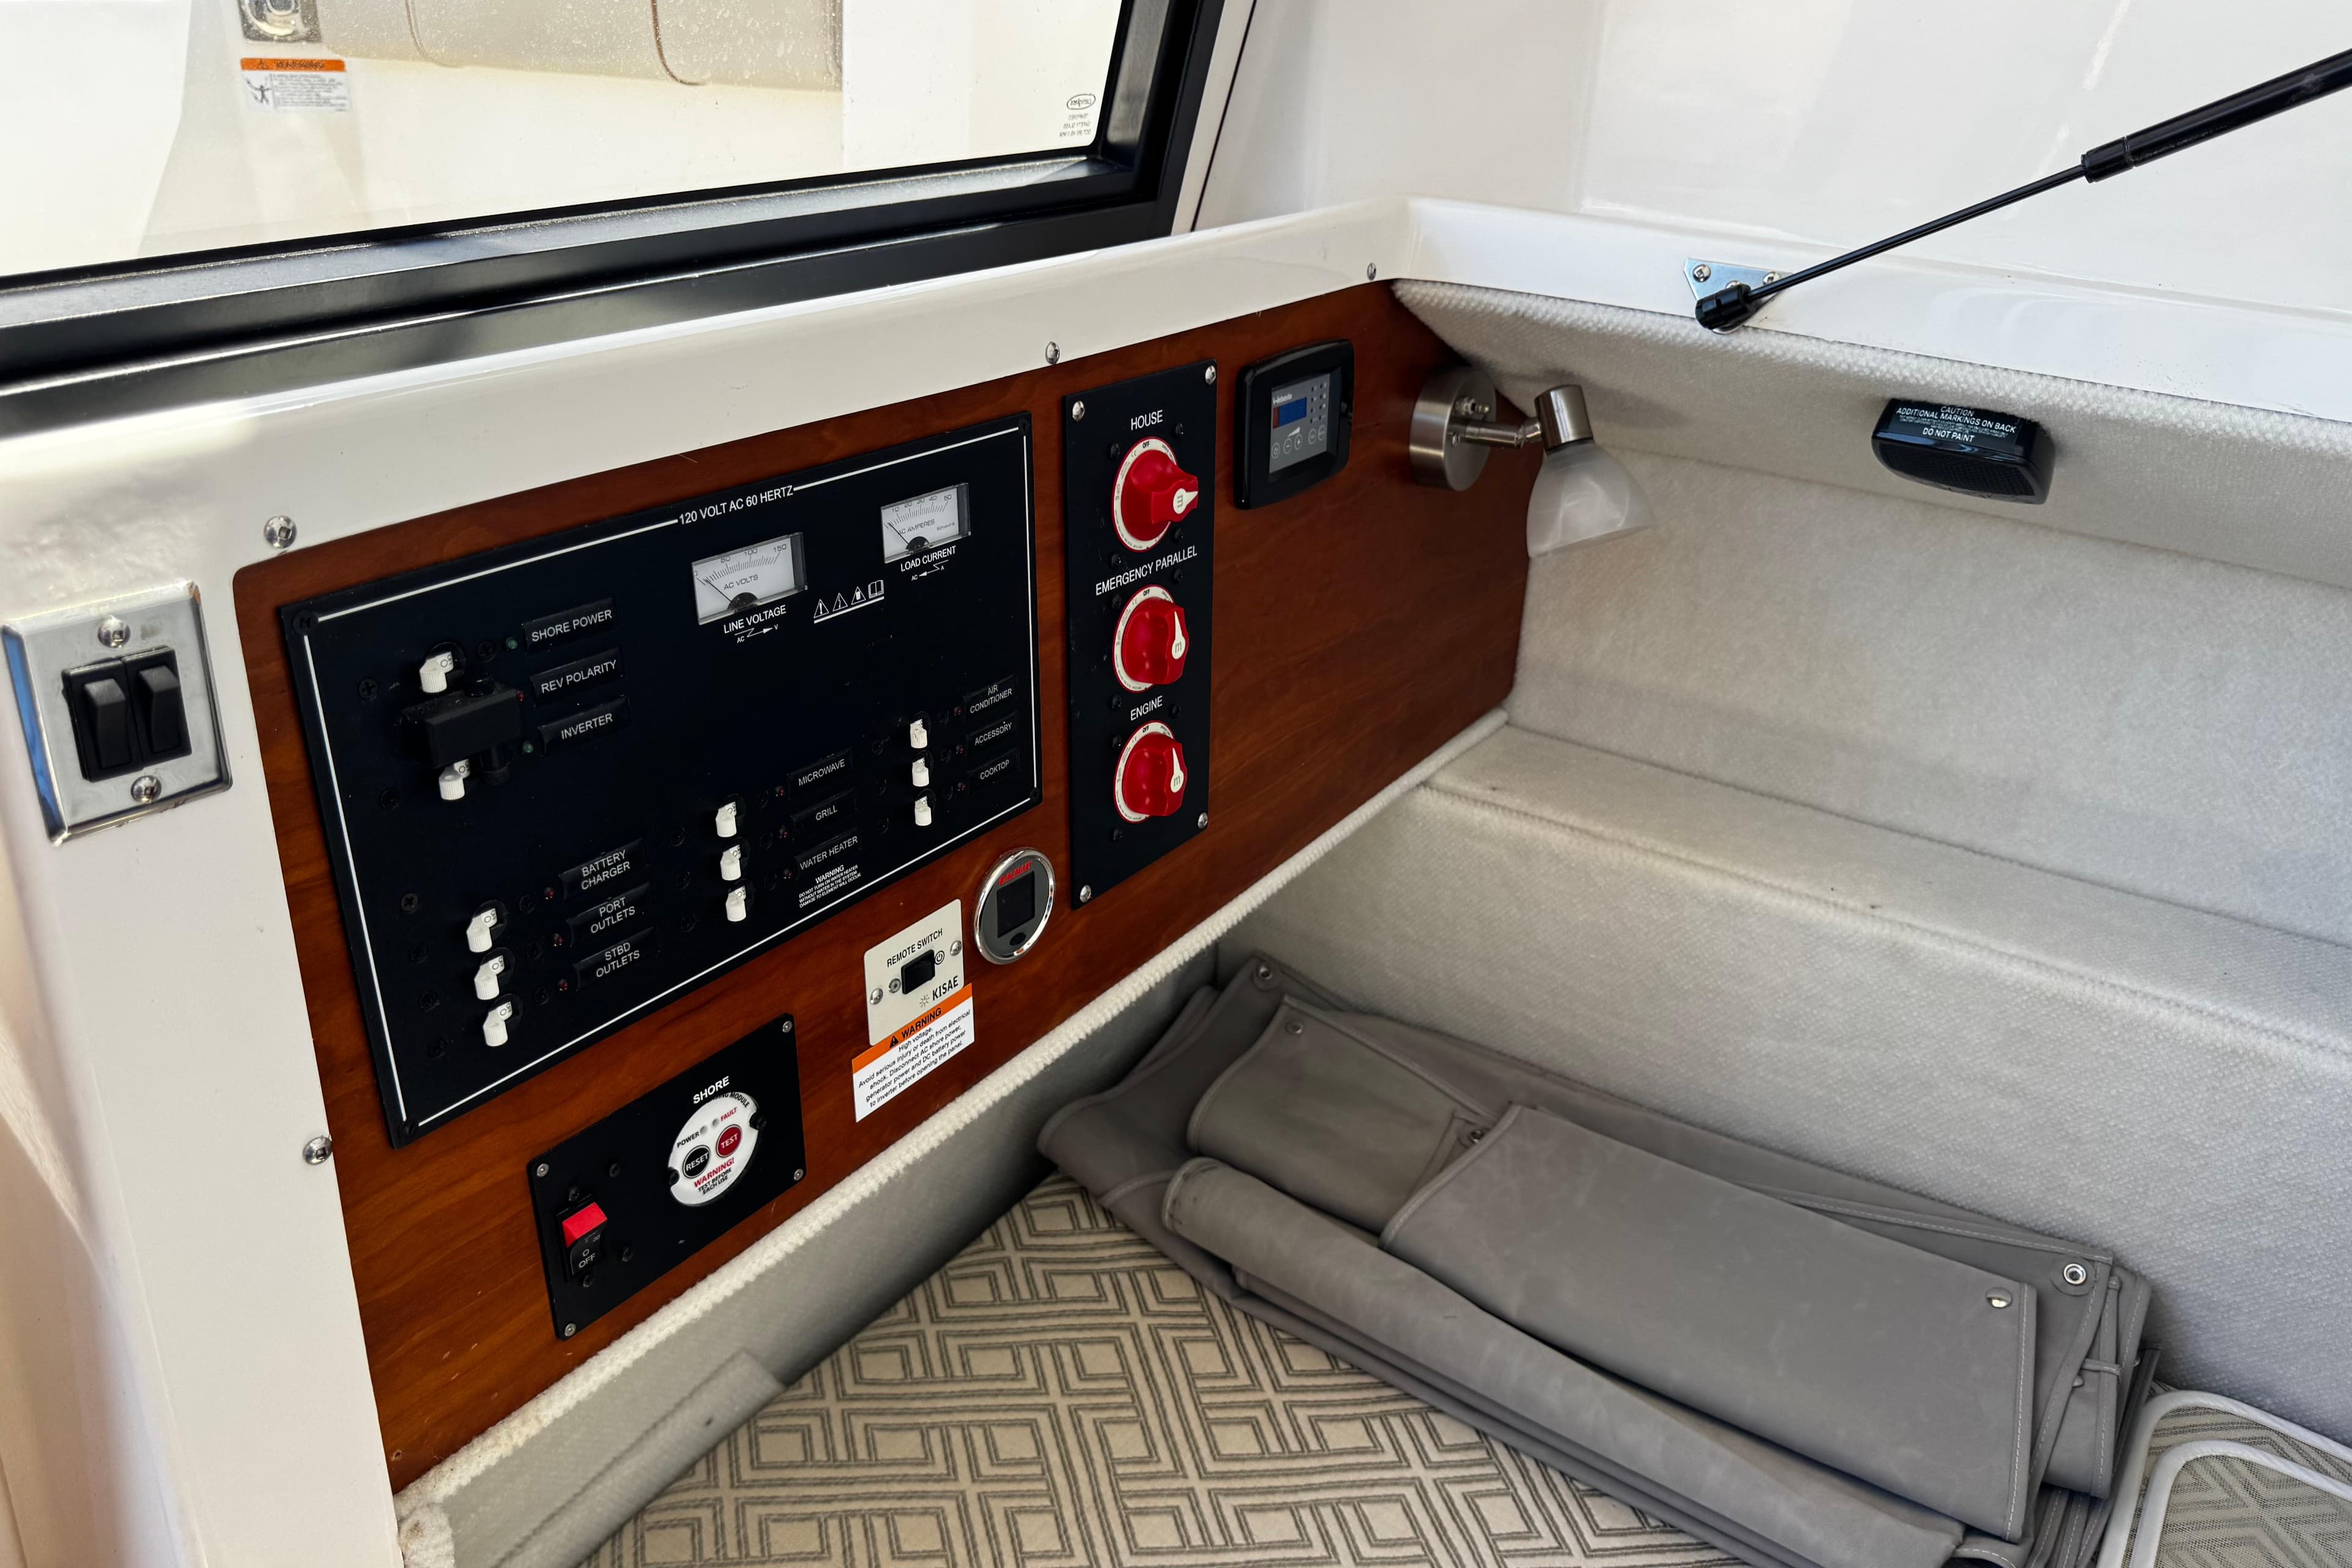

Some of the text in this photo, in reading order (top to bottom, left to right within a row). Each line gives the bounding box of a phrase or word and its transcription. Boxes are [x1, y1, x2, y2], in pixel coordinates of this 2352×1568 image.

[1131, 410, 1163, 431] HOUSE
[1896, 407, 1939, 419] ADDITIONAL
[1940, 413, 1981, 426] MARKINGS
[1994, 423, 2016, 433] BACK
[1940, 406, 1975, 417] CAUTION
[1934, 429, 1951, 439] NOT
[1951, 432, 1975, 443] PAINT
[679, 485, 793, 524] 120 VOLT AC 60 HERTZ
[908, 519, 935, 532] AMPERES
[774, 544, 786, 552] 150
[900, 545, 956, 571] LOAD CURRENT
[736, 574, 758, 586] VOLTS
[1095, 545, 1198, 596] EMERGENCY PARALLEL
[532, 609, 612, 642] SHORE POWER
[723, 605, 786, 634] LINE VOLTAGE
[541, 660, 616, 693] REV POLARITY
[970, 688, 1012, 714] CONDITIONER
[988, 684, 998, 696] AIR
[1131, 695, 1163, 721] ENGINE
[561, 713, 613, 740] INVERTER
[974, 722, 1012, 745] ACCESSORY
[799, 759, 845, 786] MICROWAVE
[980, 759, 1009, 780] COOKTOP
[815, 805, 838, 821] GRILL
[582, 850, 626, 877] BATTERY
[799, 836, 858, 870] WATER HEATER
[581, 861, 630, 889] CHARGER
[815, 864, 844, 884] WARNING
[831, 873, 843, 882] WATER
[799, 891, 816, 903] WITHOUT
[817, 884, 830, 894] WATER
[822, 884, 839, 896] ELEMENT
[591, 906, 635, 933] OUTLETS
[600, 897, 626, 917] PORT
[605, 942, 631, 961] STBD
[887, 928, 943, 968] REMOTE SWITCH
[597, 950, 640, 977] OUTLETS
[932, 975, 959, 1001] KISAE
[901, 1008, 941, 1039] WARNING
[859, 1075, 875, 1088] Avoid
[875, 1061, 896, 1077] serious
[897, 1050, 912, 1063] injury
[919, 1035, 935, 1048] death
[935, 1026, 948, 1038] from
[948, 1009, 970, 1028] electrical
[899, 1027, 933, 1052] High voltage.
[865, 1030, 966, 1102] generator power and DC battery power
[870, 1076, 889, 1090] shock.
[889, 1054, 919, 1077] Disconnect
[920, 1046, 929, 1055] AC
[930, 1037, 944, 1049] shore
[876, 1087, 897, 1103] inverter
[899, 1074, 916, 1090] before
[916, 1059, 938, 1077] opening
[938, 1053, 948, 1062] the
[948, 1041, 964, 1056] panel.
[693, 1076, 730, 1104] SHORE
[729, 1092, 750, 1108] MODULE
[720, 1107, 737, 1122] FAULT
[677, 1131, 699, 1148] POWER
[720, 1133, 738, 1149] TEST
[685, 1153, 709, 1172] RESET
[693, 1157, 735, 1188] WARNING!
[698, 1168, 733, 1193] TEST BEFORE
[703, 1175, 729, 1195] EACH USE
[579, 1253, 595, 1268] OFF
